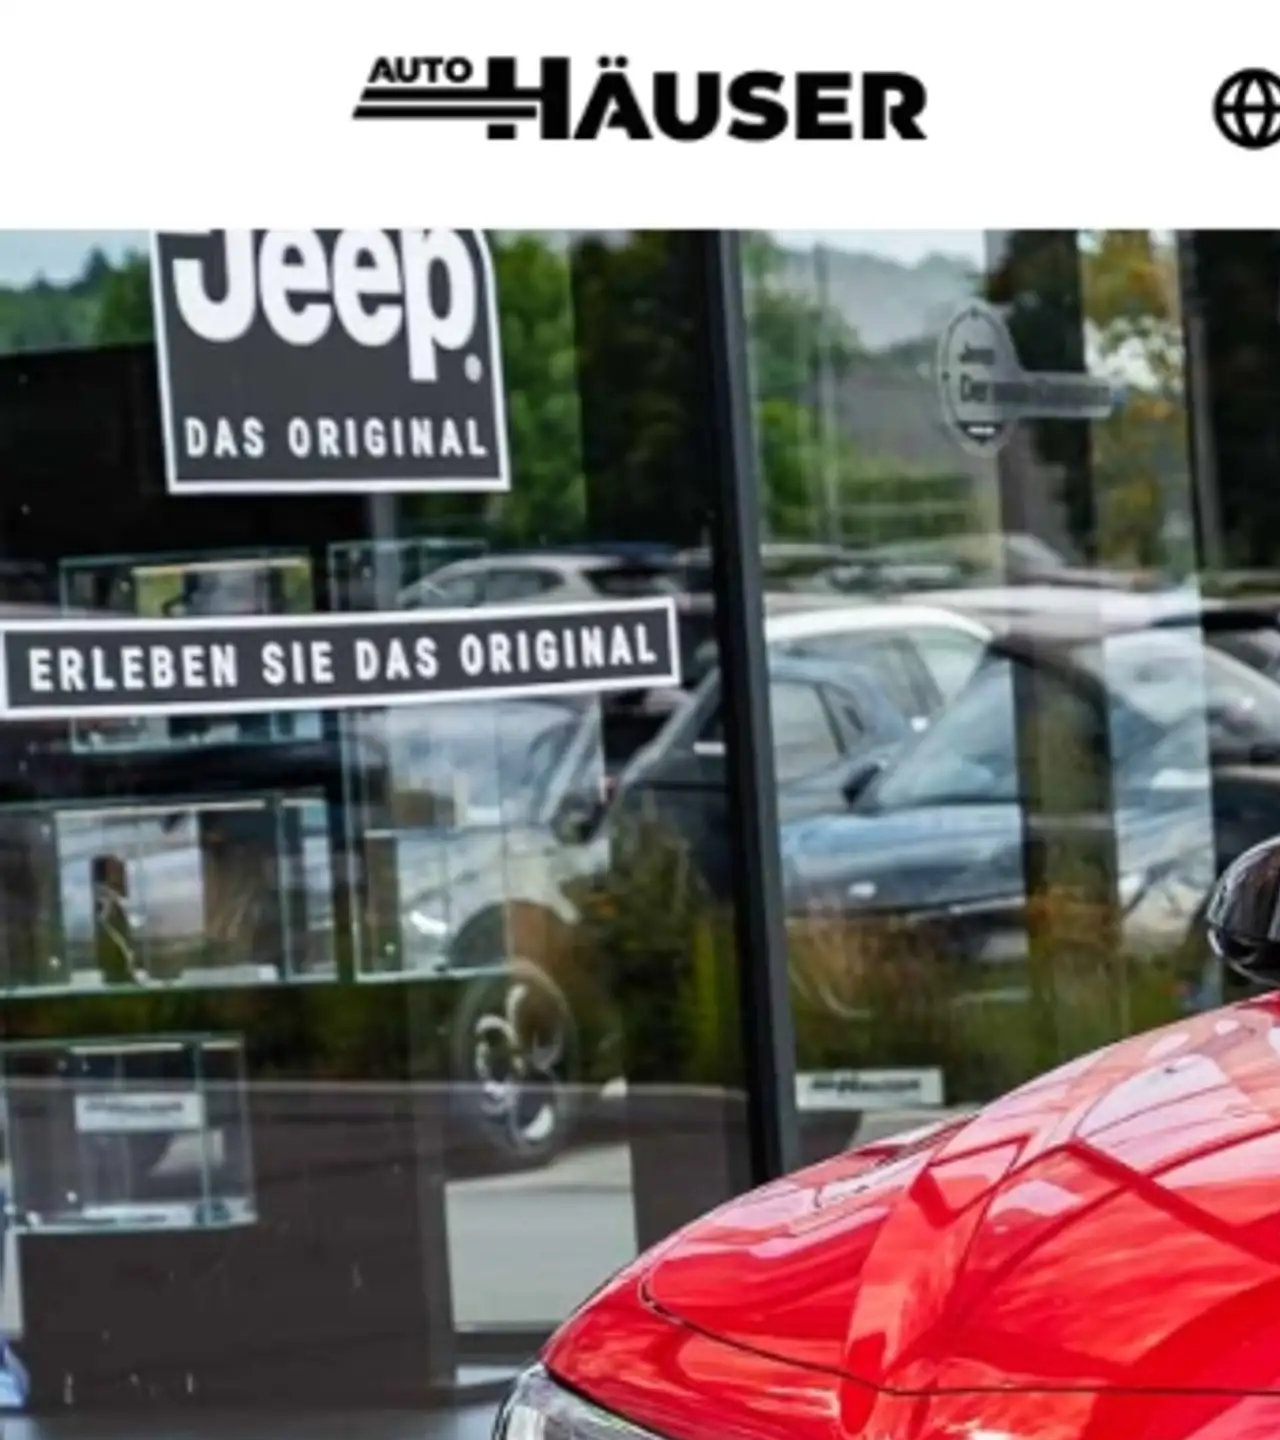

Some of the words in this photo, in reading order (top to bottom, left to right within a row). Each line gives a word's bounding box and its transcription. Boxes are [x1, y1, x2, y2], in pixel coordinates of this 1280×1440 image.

[172, 229, 478, 382] Jeep
[184, 416, 265, 458] DAS
[287, 416, 488, 458] ORIGINAL
[27, 644, 238, 692] ERLEBEN
[261, 638, 336, 684] SIE
[354, 636, 440, 682] DAS
[458, 623, 658, 676] ORIGINAL
